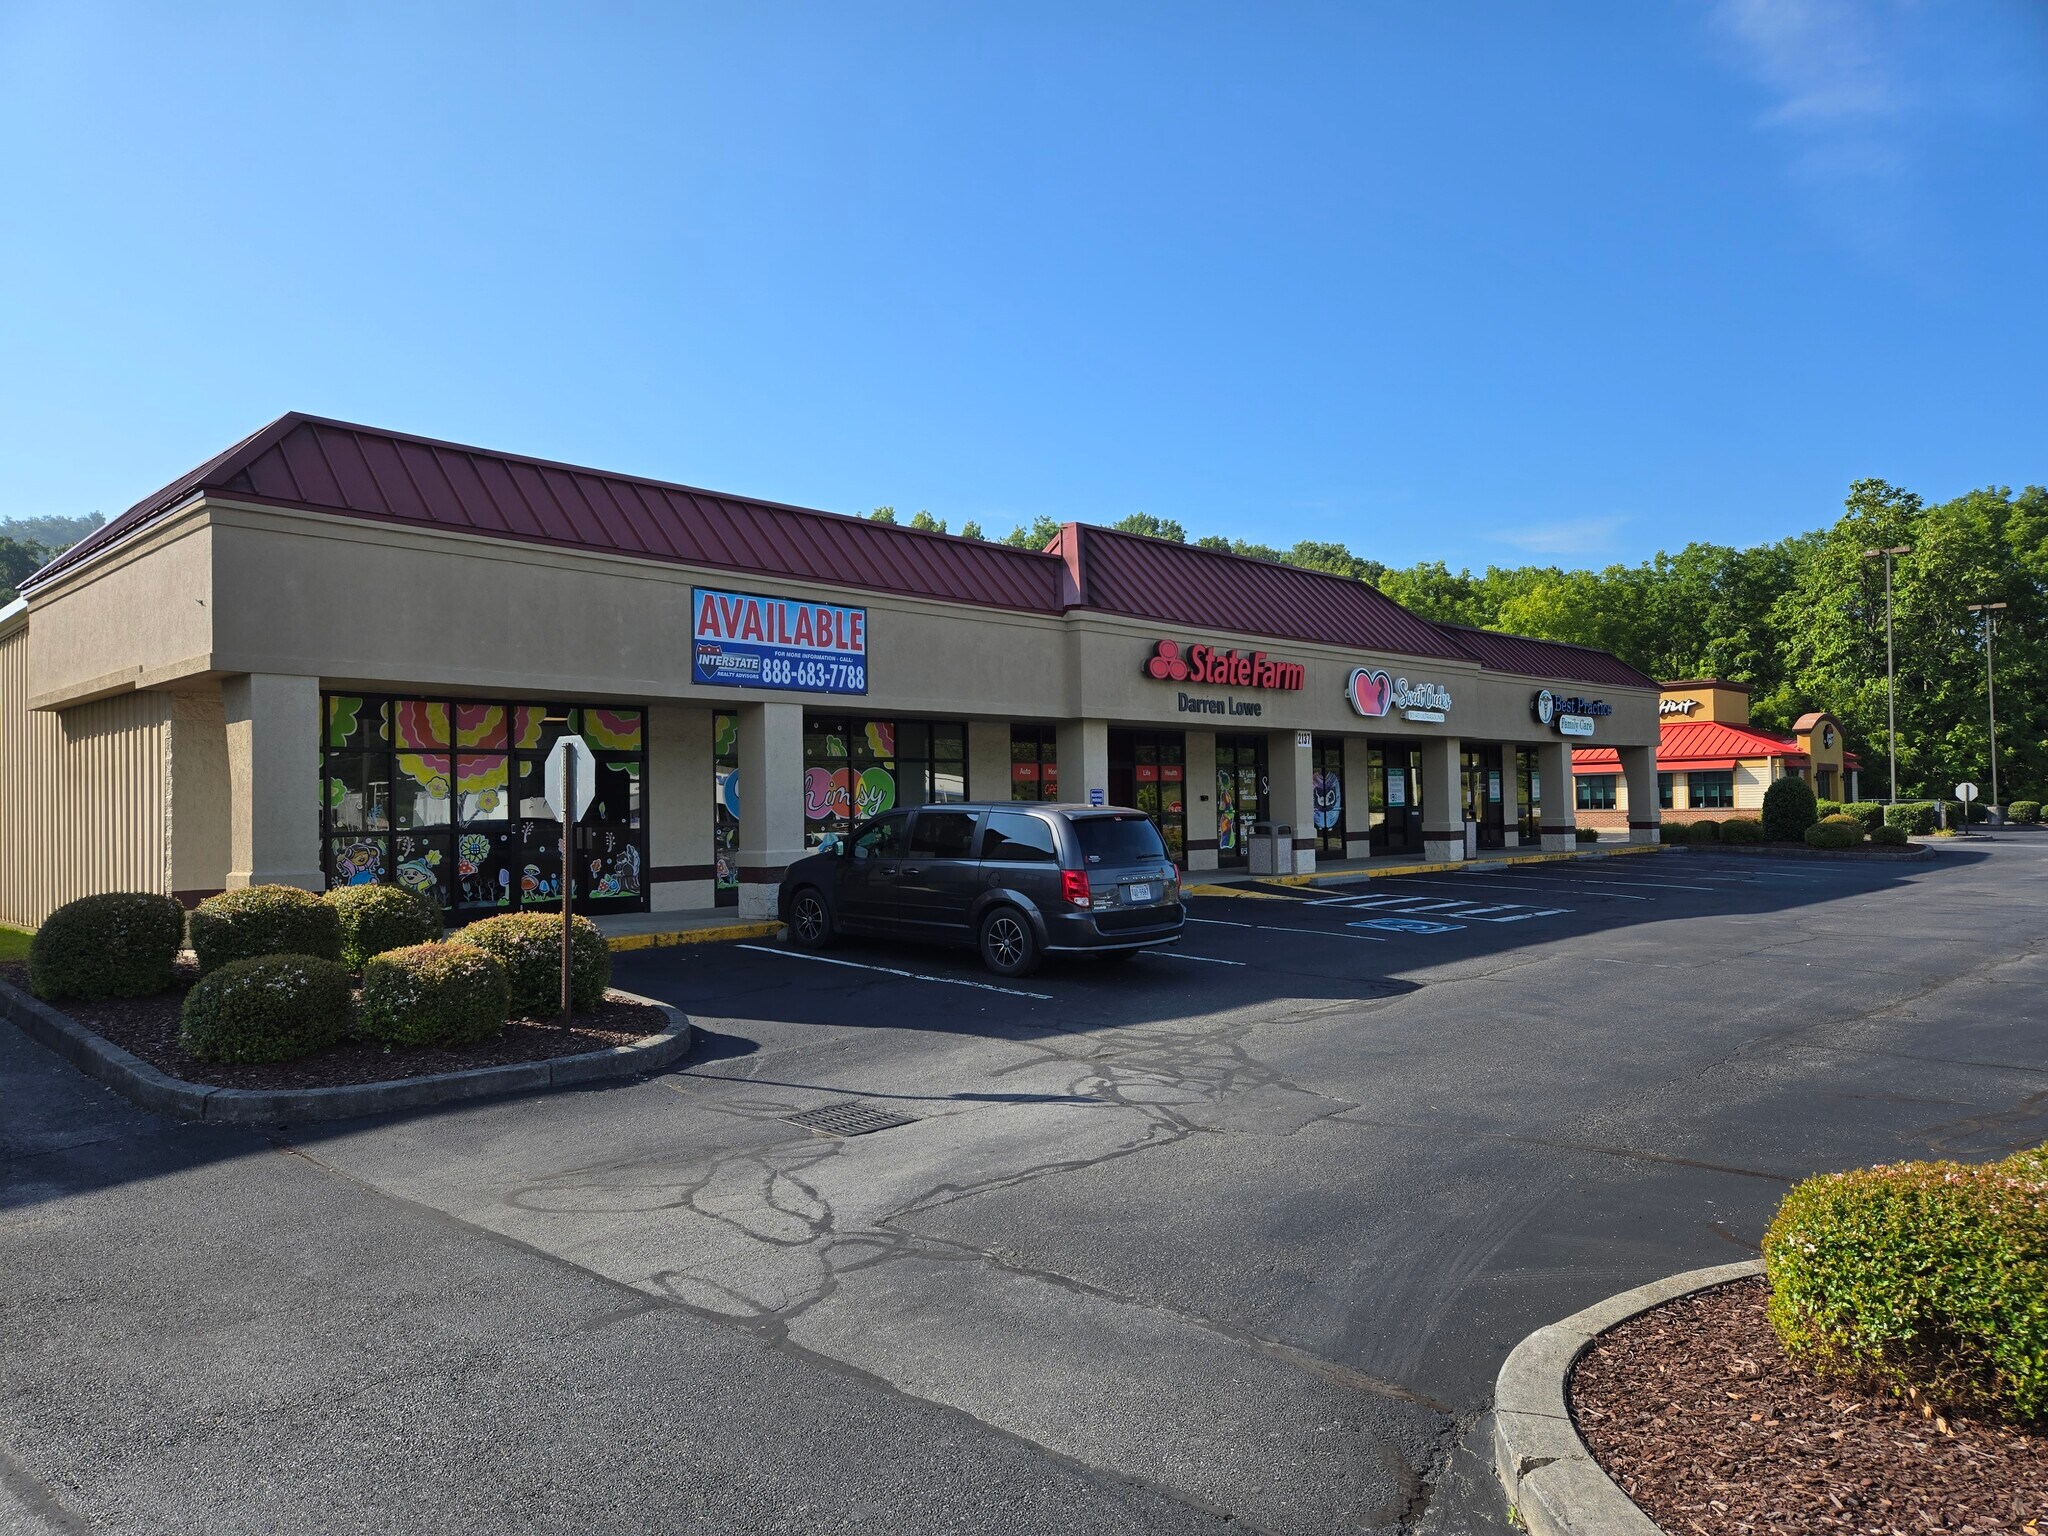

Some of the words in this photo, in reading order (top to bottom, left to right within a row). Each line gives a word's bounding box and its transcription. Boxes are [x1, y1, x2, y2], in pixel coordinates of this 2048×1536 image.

[697, 594, 863, 651] AVAILABLE
[698, 654, 759, 669] INTERSTATE
[786, 651, 802, 659] MORE
[802, 653, 837, 662] INFORMATION
[735, 672, 759, 680] ADVISORS
[762, 659, 865, 690] 888-683-7788
[1397, 678, 1425, 709] Sweet
[1425, 683, 1452, 712] Cheeks
[1178, 692, 1226, 715] Darren
[1228, 696, 1262, 717] Lowe
[1554, 694, 1577, 713] Best
[1576, 696, 1613, 716] Practice
[1659, 699, 1697, 714] Hut
[1561, 717, 1579, 732] Family
[1579, 719, 1593, 731] Care
[1297, 732, 1310, 745] 2137
[1019, 767, 1032, 775] Auto
